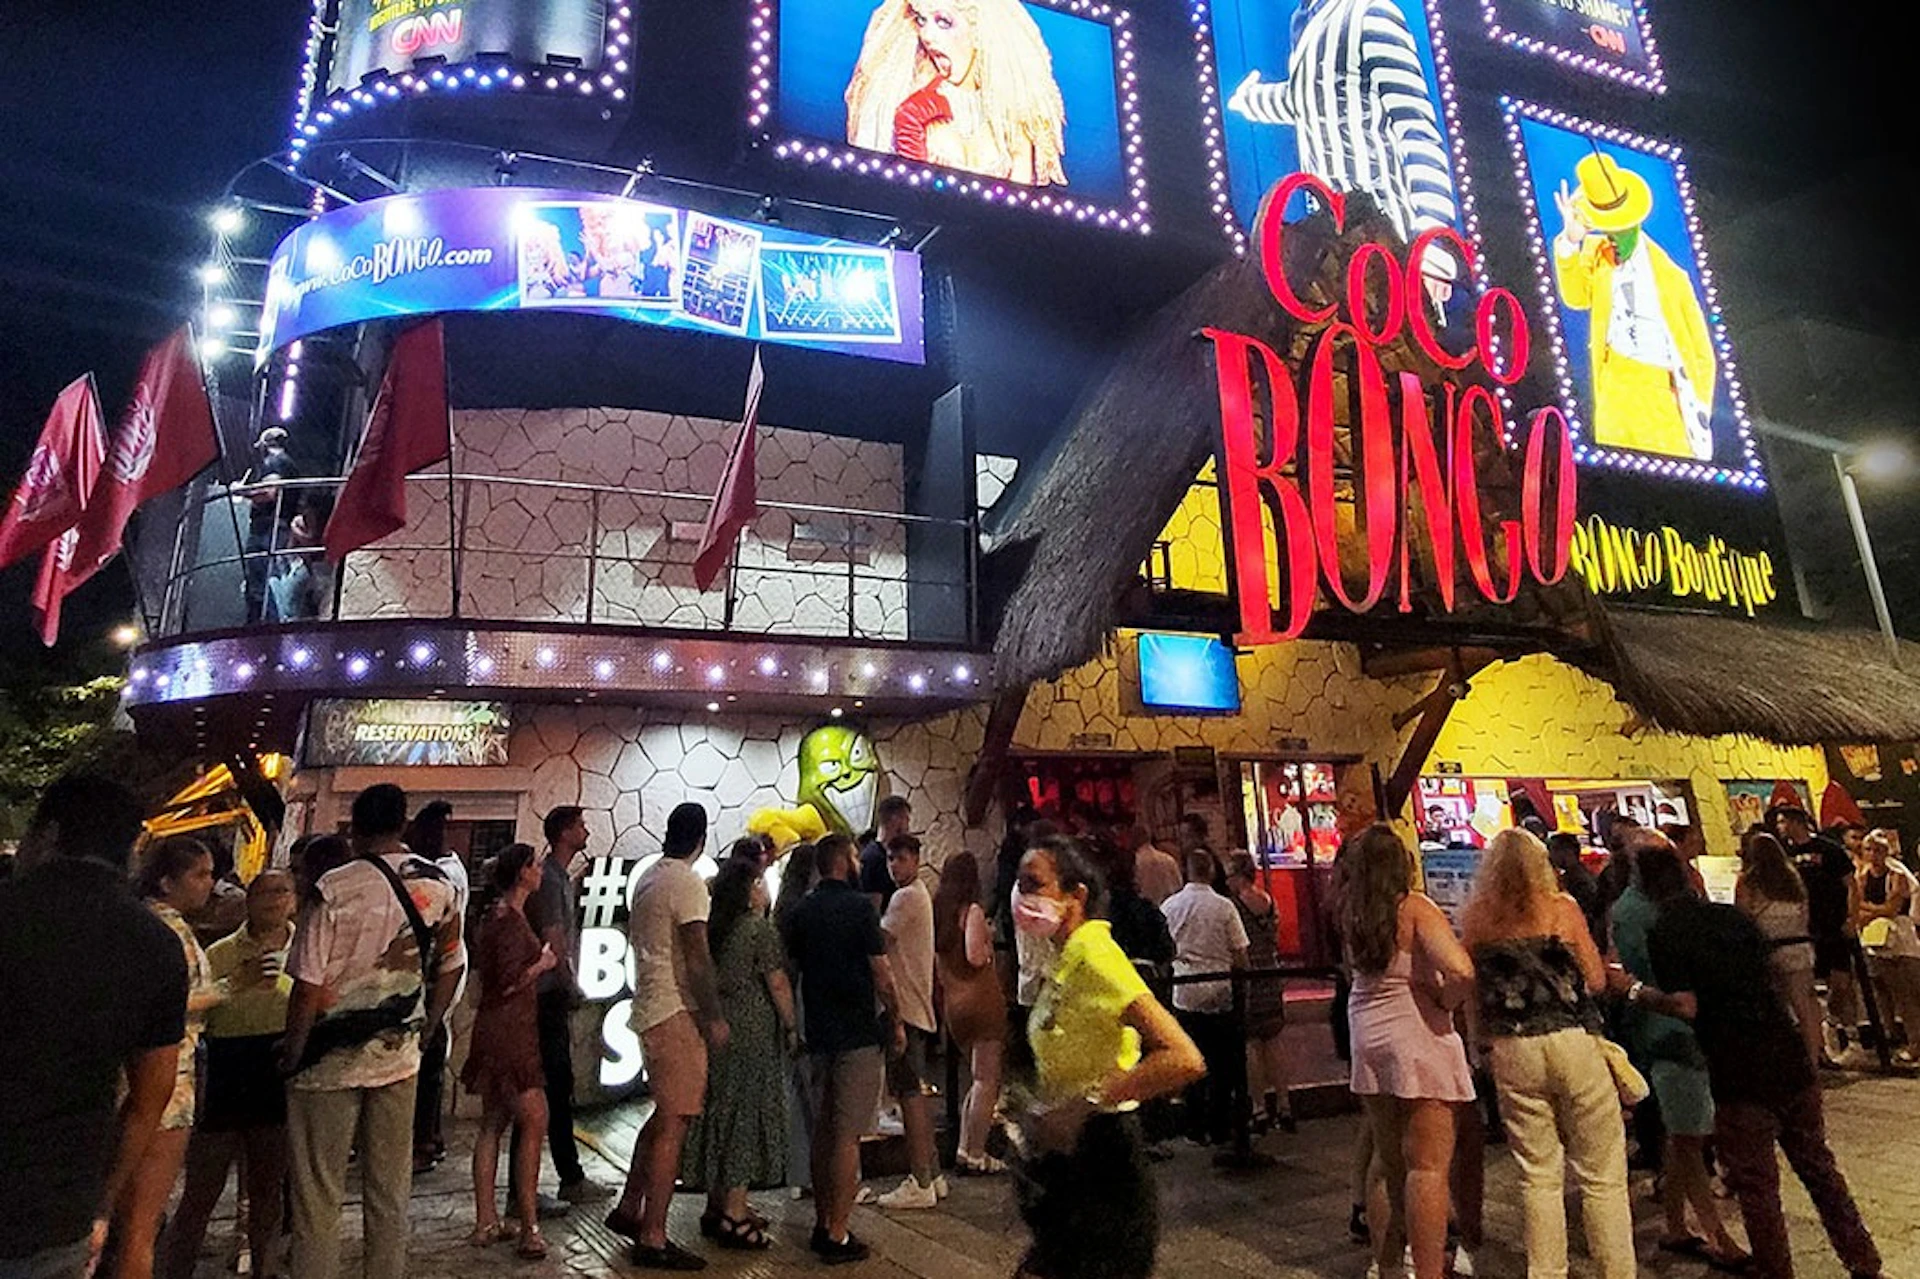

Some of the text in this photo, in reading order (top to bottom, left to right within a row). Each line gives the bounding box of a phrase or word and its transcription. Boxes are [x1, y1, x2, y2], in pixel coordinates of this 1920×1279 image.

[392, 8, 463, 54] CNN
[1201, 321, 1577, 645] BONGO
[1661, 526, 1776, 617] Boutique
[354, 723, 475, 742] RESERVATIONS
